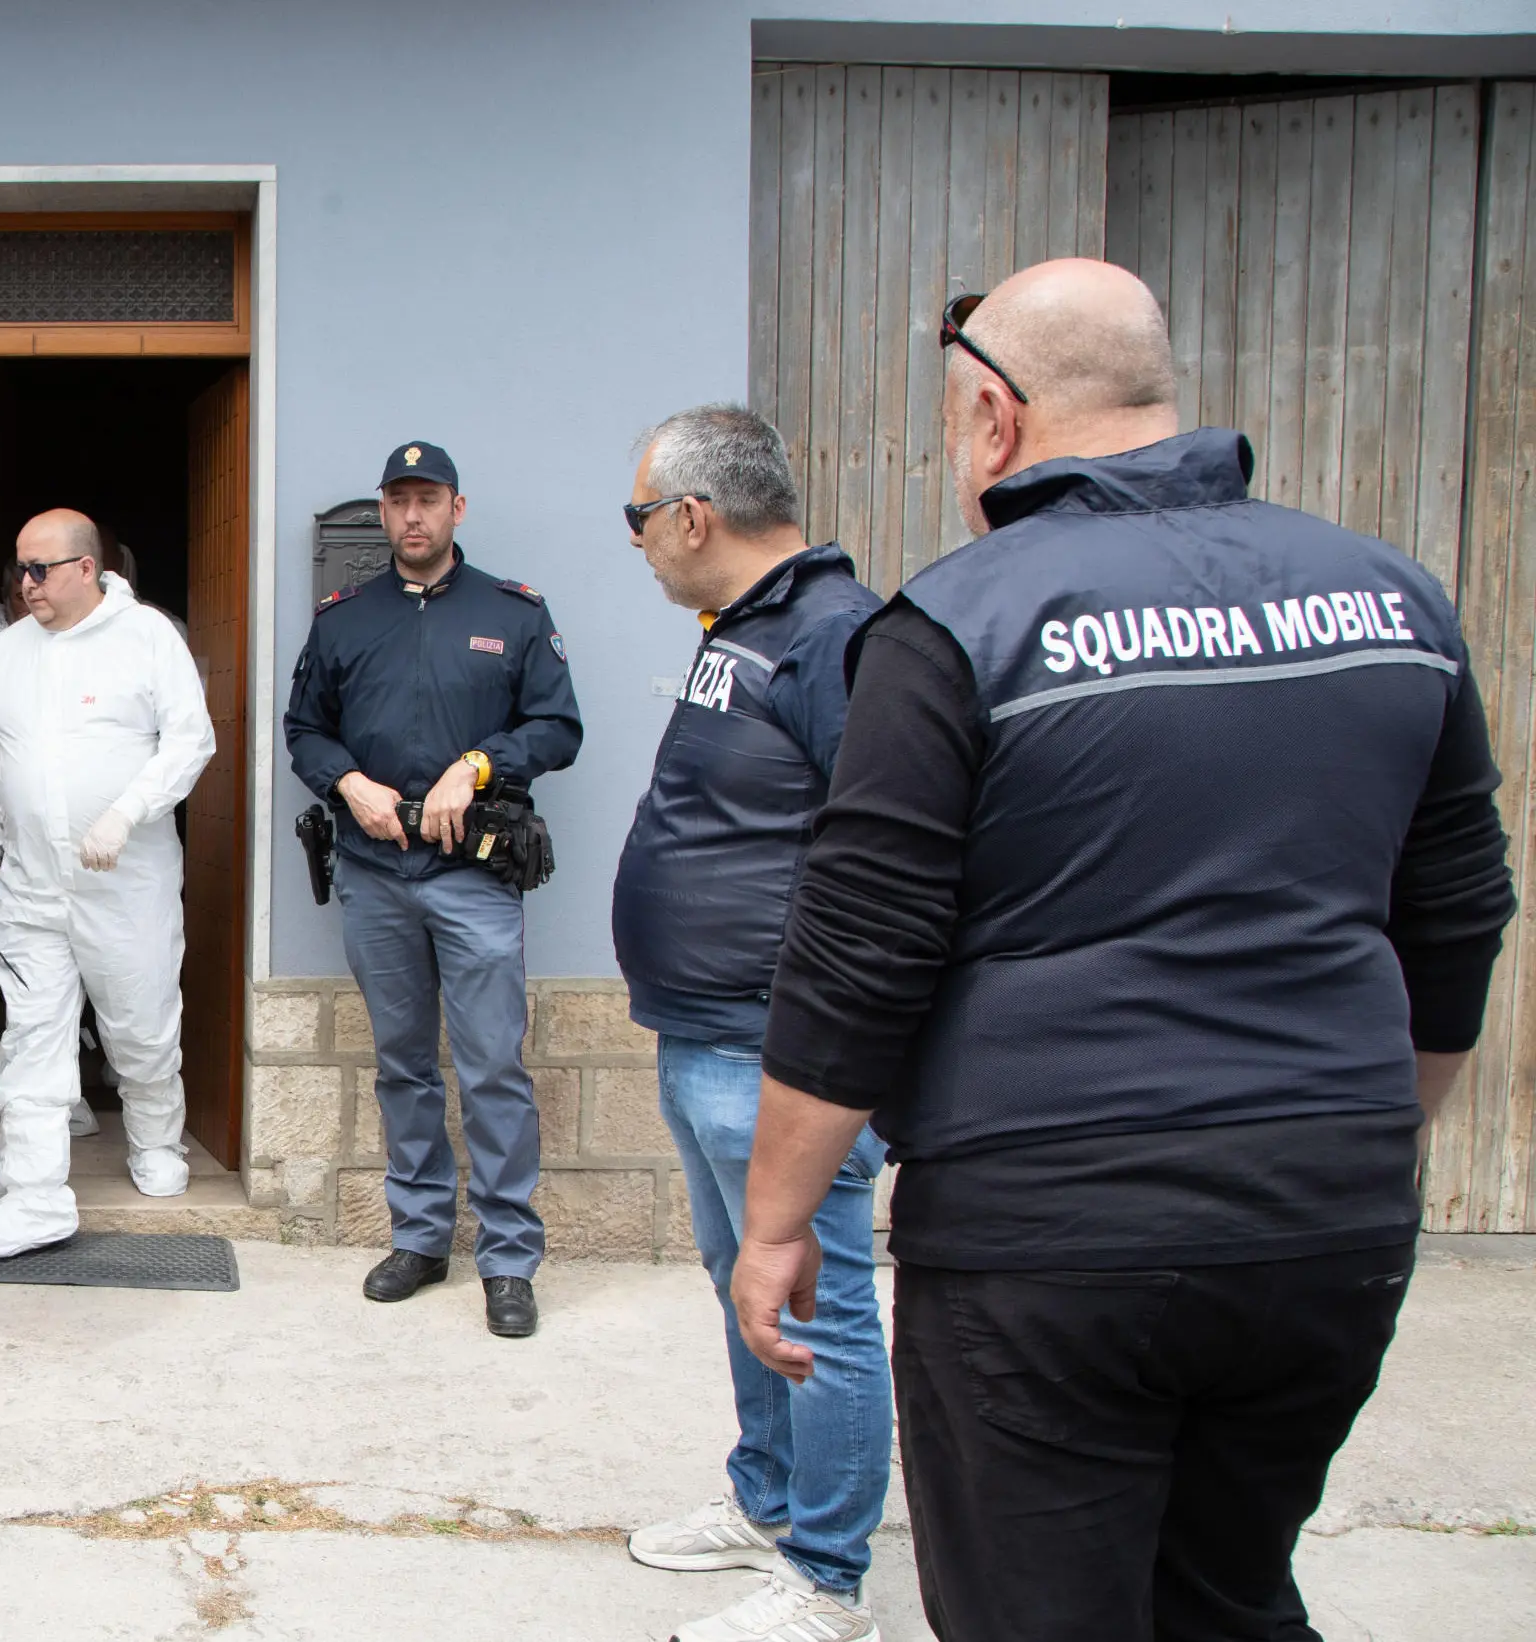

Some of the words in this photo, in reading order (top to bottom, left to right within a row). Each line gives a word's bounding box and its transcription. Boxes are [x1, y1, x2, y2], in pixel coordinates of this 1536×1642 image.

[472, 639, 502, 651] POLIZIA
[1040, 605, 1263, 675] SQUADRA
[1262, 591, 1414, 652] MOBILE
[680, 651, 738, 712] IZIA
